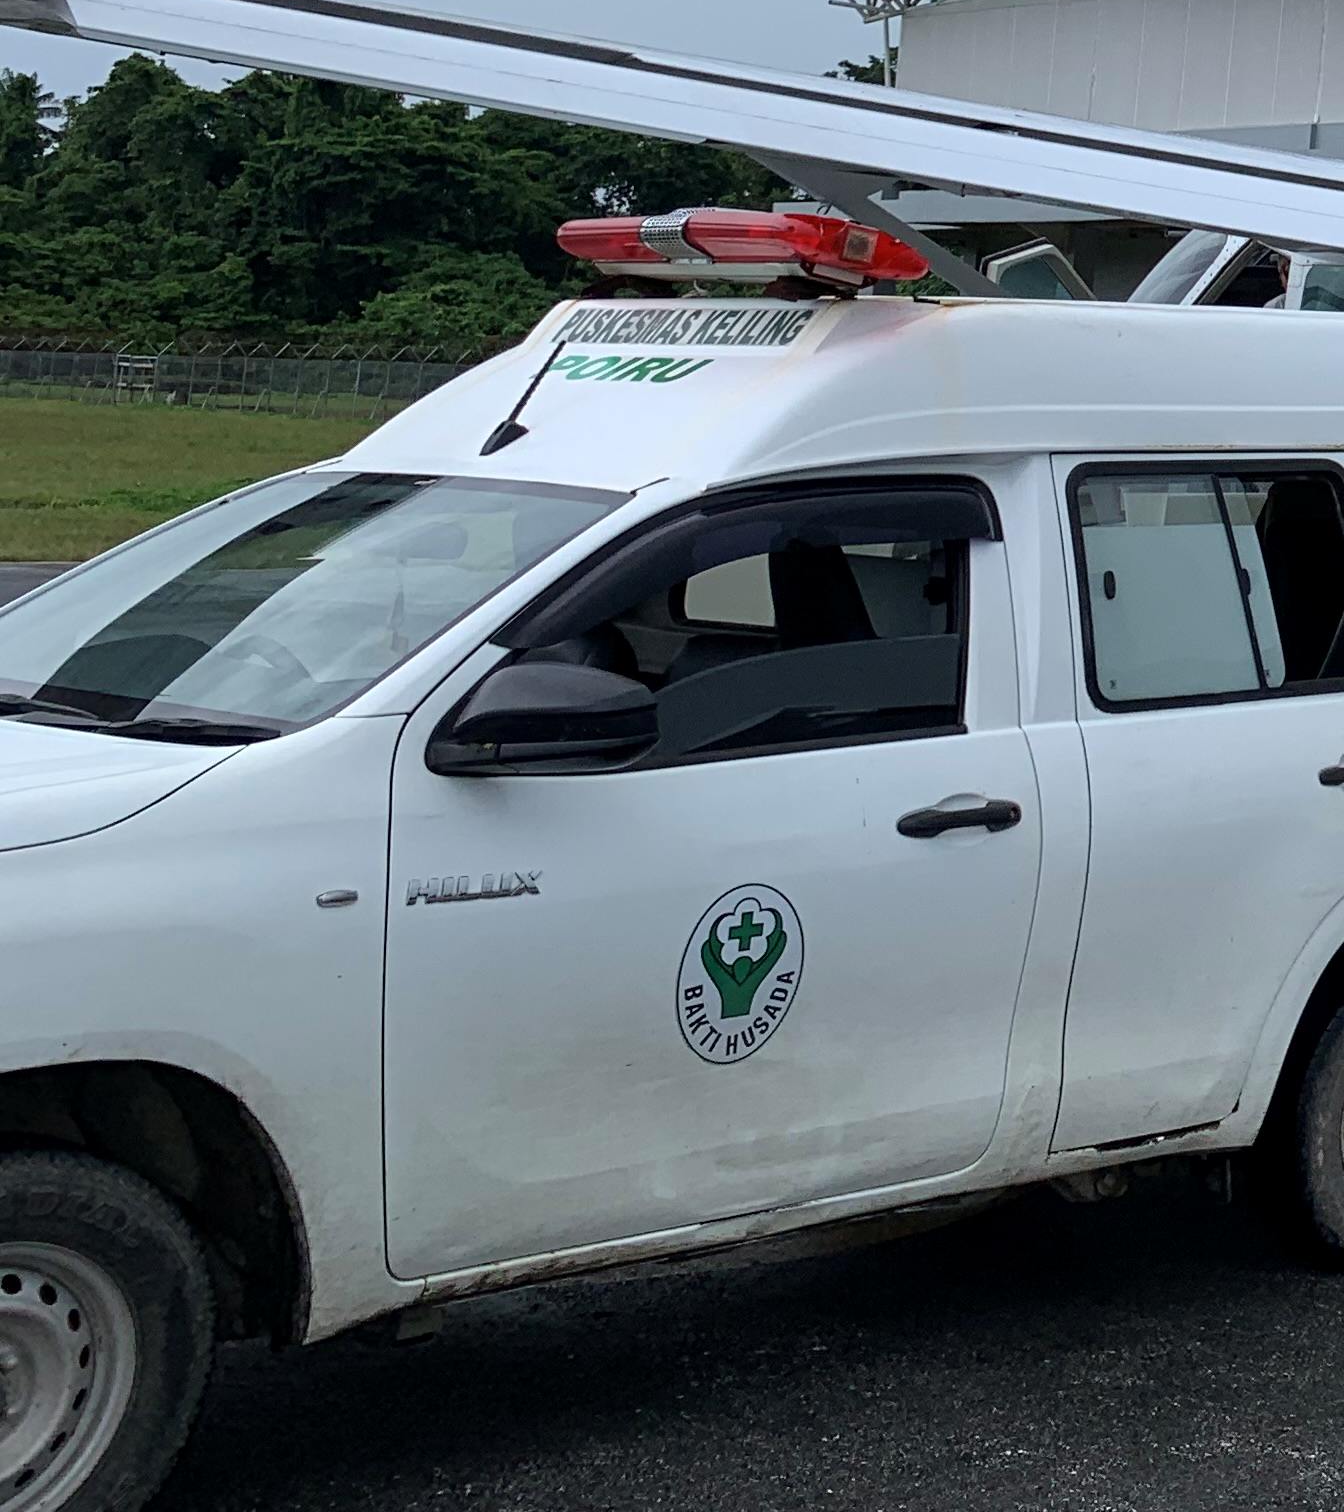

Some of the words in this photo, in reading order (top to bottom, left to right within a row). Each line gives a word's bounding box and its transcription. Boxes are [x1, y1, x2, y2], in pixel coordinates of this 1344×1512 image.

[551, 308, 699, 345] PUSKESMAS
[687, 308, 814, 346] KELILING
[531, 355, 715, 383] POIRU
[406, 870, 543, 906] HILUX
[684, 984, 722, 1053] BAKTI
[725, 970, 796, 1056] HUSADA
